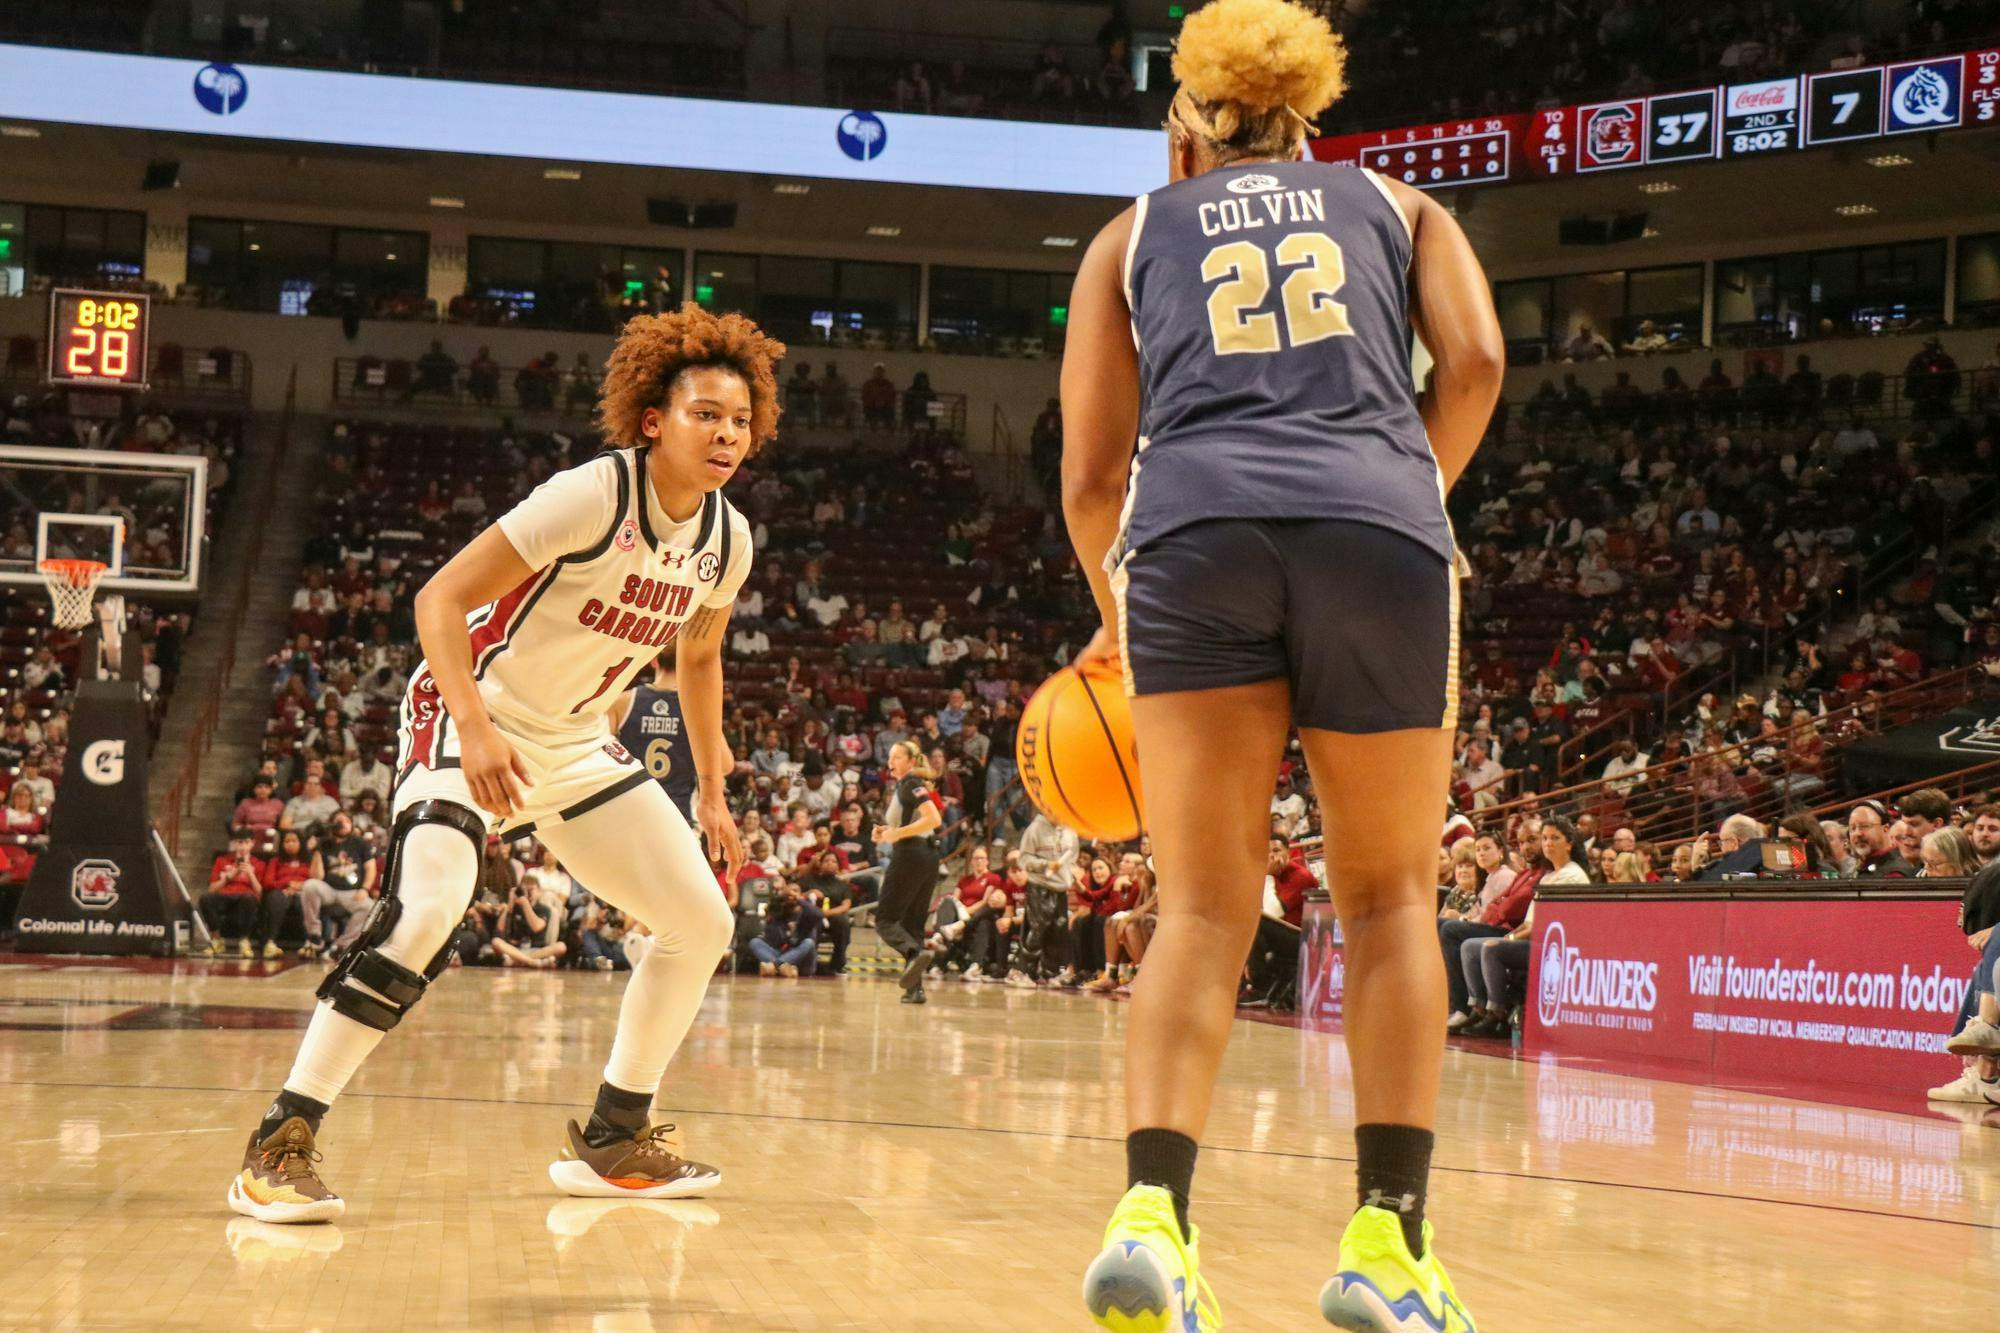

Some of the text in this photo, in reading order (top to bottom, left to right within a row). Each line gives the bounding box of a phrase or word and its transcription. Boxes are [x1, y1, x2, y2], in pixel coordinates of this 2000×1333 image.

[1977, 52, 2000, 64] TO
[1978, 65, 1996, 84] 3
[1972, 88, 2000, 102] FLS
[1544, 111, 1564, 123] TO
[1831, 92, 1860, 125] 7
[1977, 101, 1994, 120] 3
[1380, 120, 1502, 145] 1 5 11 24 30
[1545, 124, 1562, 140] 4
[1655, 112, 1708, 146] 37
[1744, 114, 1778, 129] 2ND
[1377, 154, 1390, 167] 0
[1404, 151, 1416, 164] 0
[1459, 144, 1471, 157] 2
[1487, 141, 1498, 153] 6
[1541, 144, 1566, 157] FLS
[1733, 130, 1788, 153] 8:02
[1403, 160, 1499, 183] 0 0 1 0
[1547, 156, 1558, 174] 1
[1199, 189, 1325, 237] COLVIN
[1200, 232, 1355, 356] 22
[78, 300, 139, 330] 8:02
[68, 328, 128, 376] 28
[619, 573, 694, 617] SOUTH
[570, 657, 634, 714] 1
[641, 715, 680, 735] FREIRE
[82, 740, 126, 785] G
[645, 738, 673, 778] 6
[19, 918, 165, 936] Colonial Life Arena
[1561, 947, 1658, 1012] FOUNDERS
[1688, 955, 1977, 1014] Visit foundersfcu.com today
[1561, 1010, 1653, 1032] FEDERAL CREDIT UNION
[1693, 1012, 1729, 1032] FEDERALLY
[1729, 1015, 1758, 1034] INSURED
[1759, 1018, 1770, 1036] BY
[1796, 1021, 1846, 1043] MEMBERSHIP
[1847, 1026, 1913, 1050] QUALIFICATION
